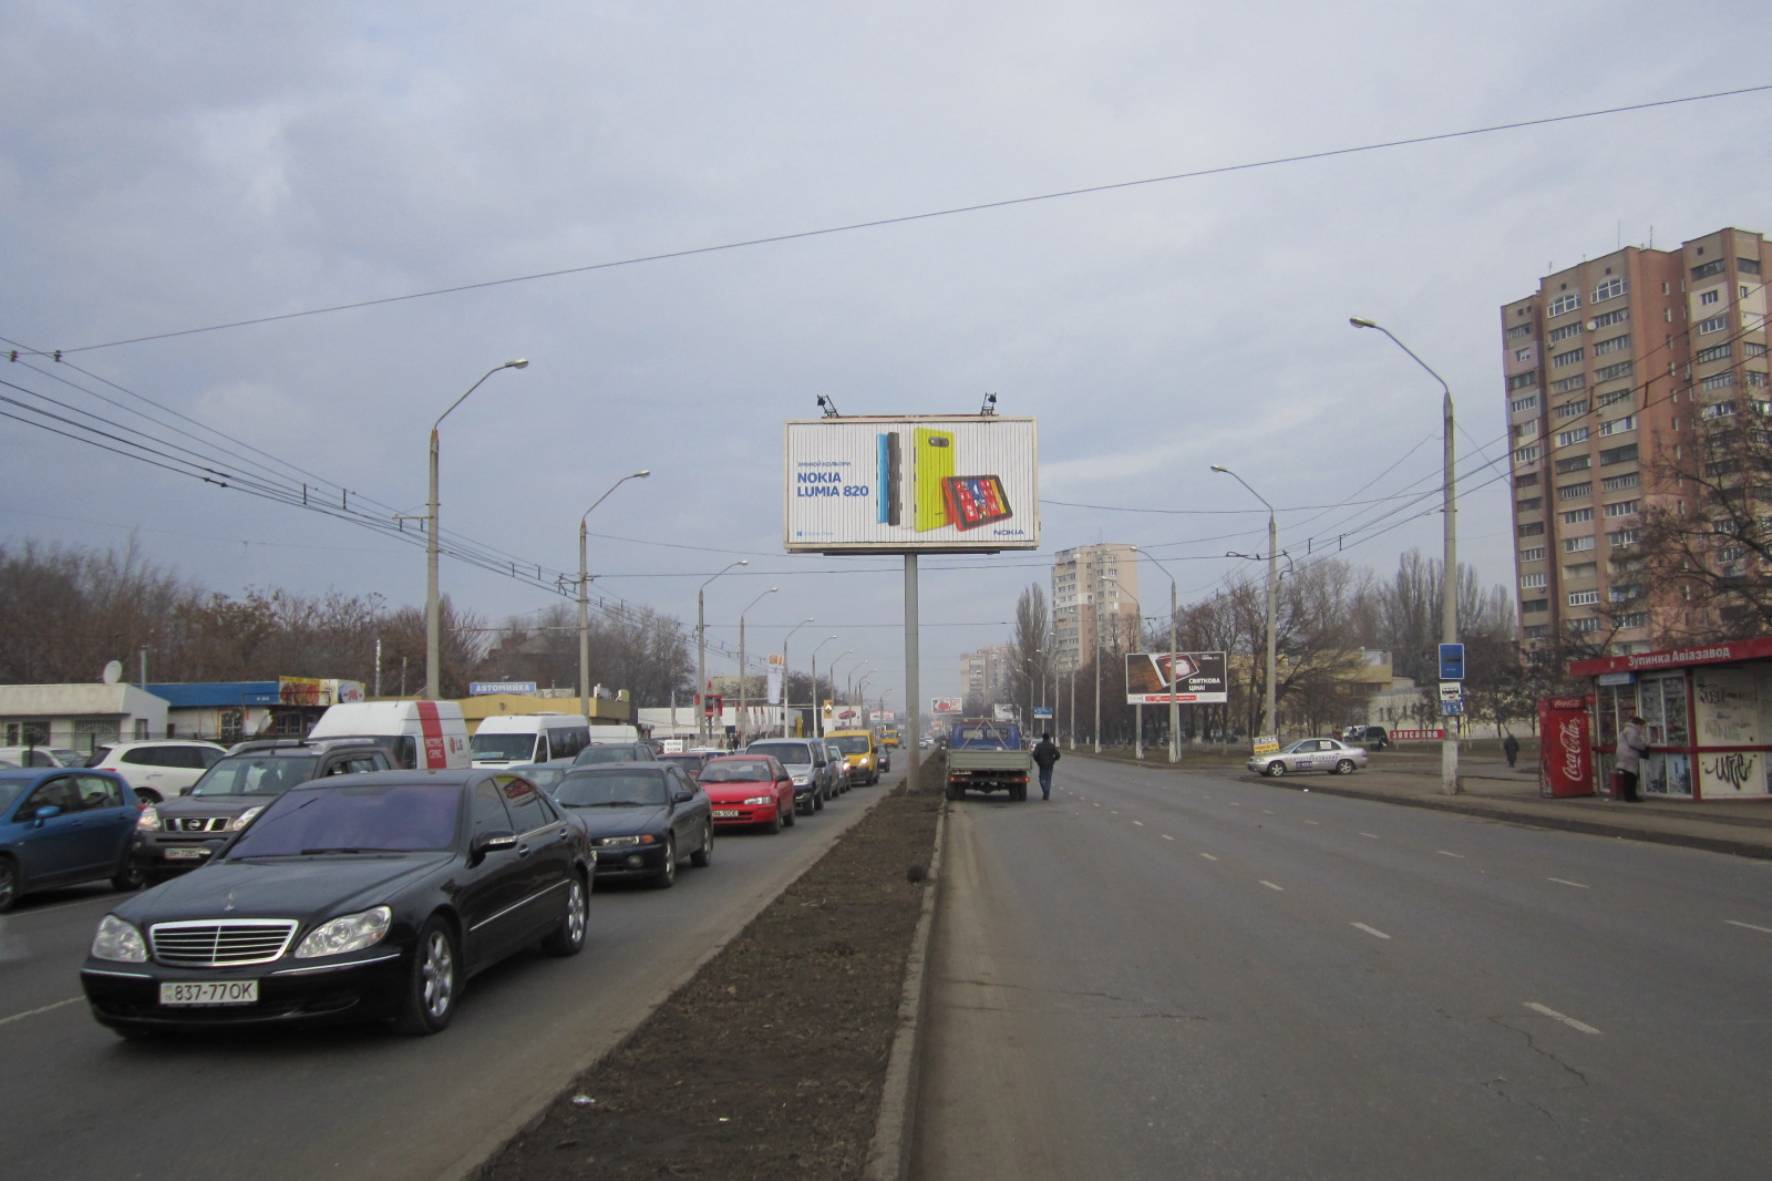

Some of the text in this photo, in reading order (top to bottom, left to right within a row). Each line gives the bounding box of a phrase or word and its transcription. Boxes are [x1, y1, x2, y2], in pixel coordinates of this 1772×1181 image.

[797, 472, 841, 483] NOKIA
[797, 485, 869, 497] LUMIA 820
[1628, 655, 1670, 669] Зупинка
